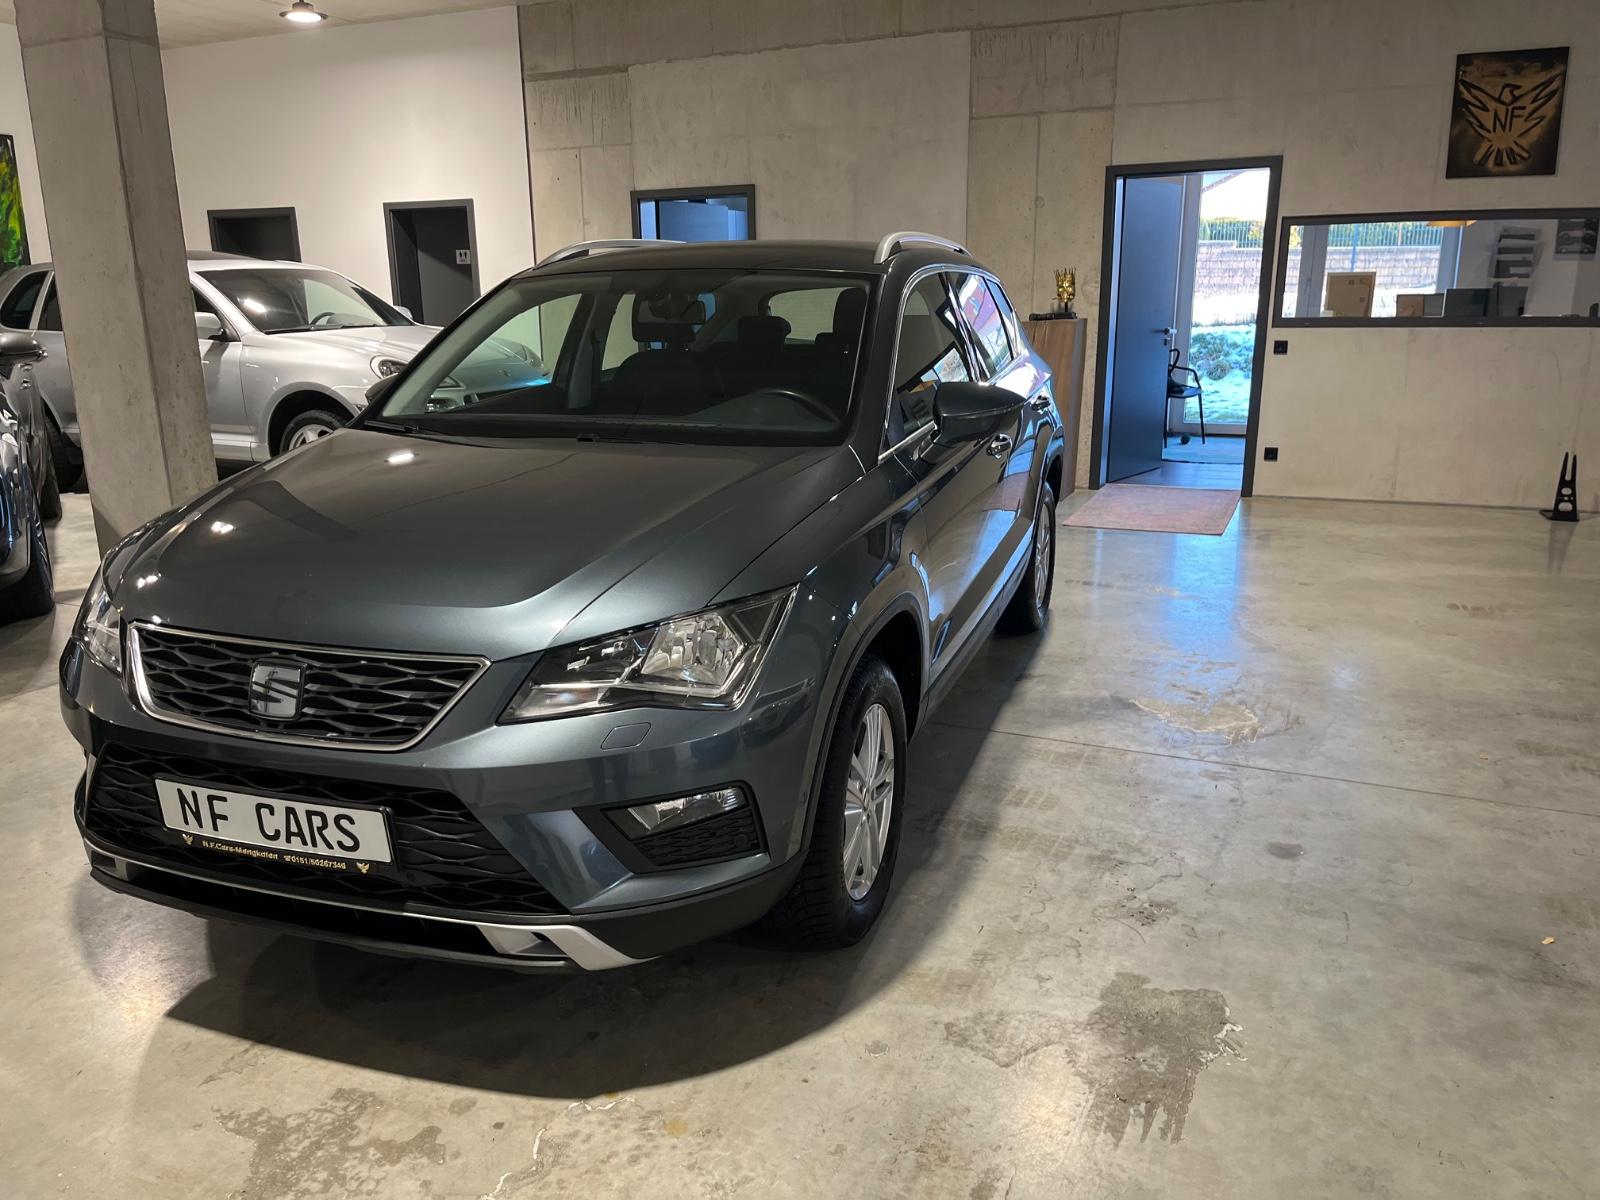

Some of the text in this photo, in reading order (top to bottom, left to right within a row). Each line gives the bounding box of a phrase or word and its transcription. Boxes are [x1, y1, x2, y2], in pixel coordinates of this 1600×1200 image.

[1492, 106, 1526, 133] NF
[176, 787, 361, 852] NF CARS
